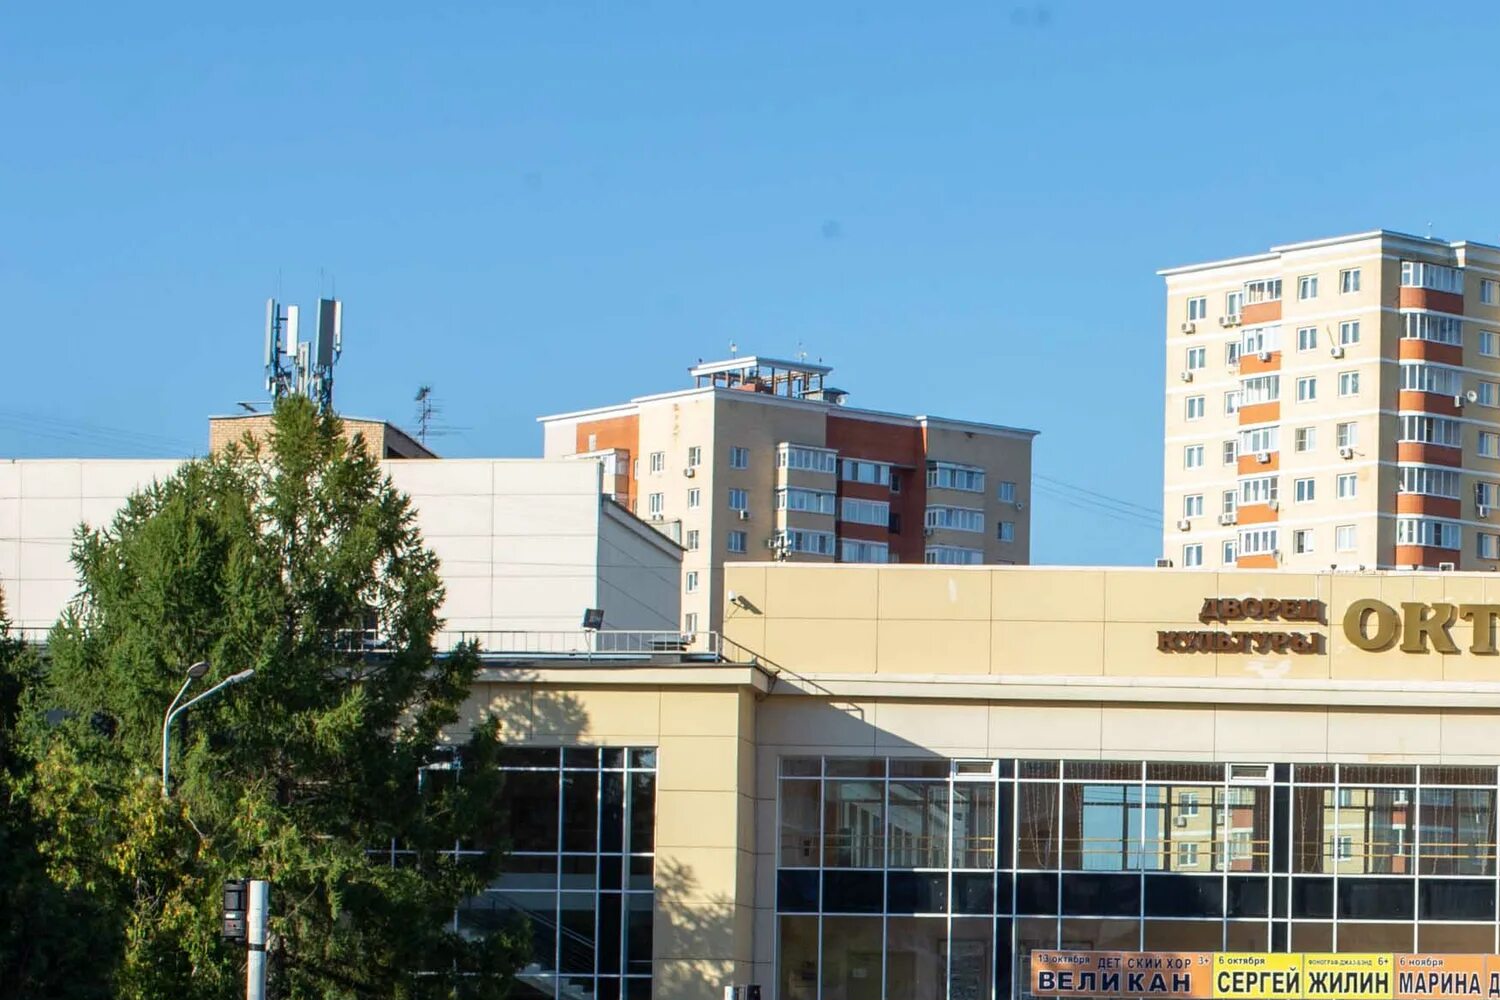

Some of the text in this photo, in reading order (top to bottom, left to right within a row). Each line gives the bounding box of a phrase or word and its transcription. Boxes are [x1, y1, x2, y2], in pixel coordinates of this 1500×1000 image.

[1198, 597, 1328, 626] ДВОРЕЦ
[1157, 630, 1327, 655] КУЛЬТУРЫ
[1052, 954, 1090, 965] октября
[1166, 957, 1191, 969] ХОР
[1218, 956, 1265, 966] 6 октября
[1377, 957, 1389, 966] 6+
[1399, 957, 1444, 967] 6 ноября
[1217, 967, 1389, 993] СЕРГЕЙ ЖИЛИН
[1399, 972, 1481, 994] МАРИНА
